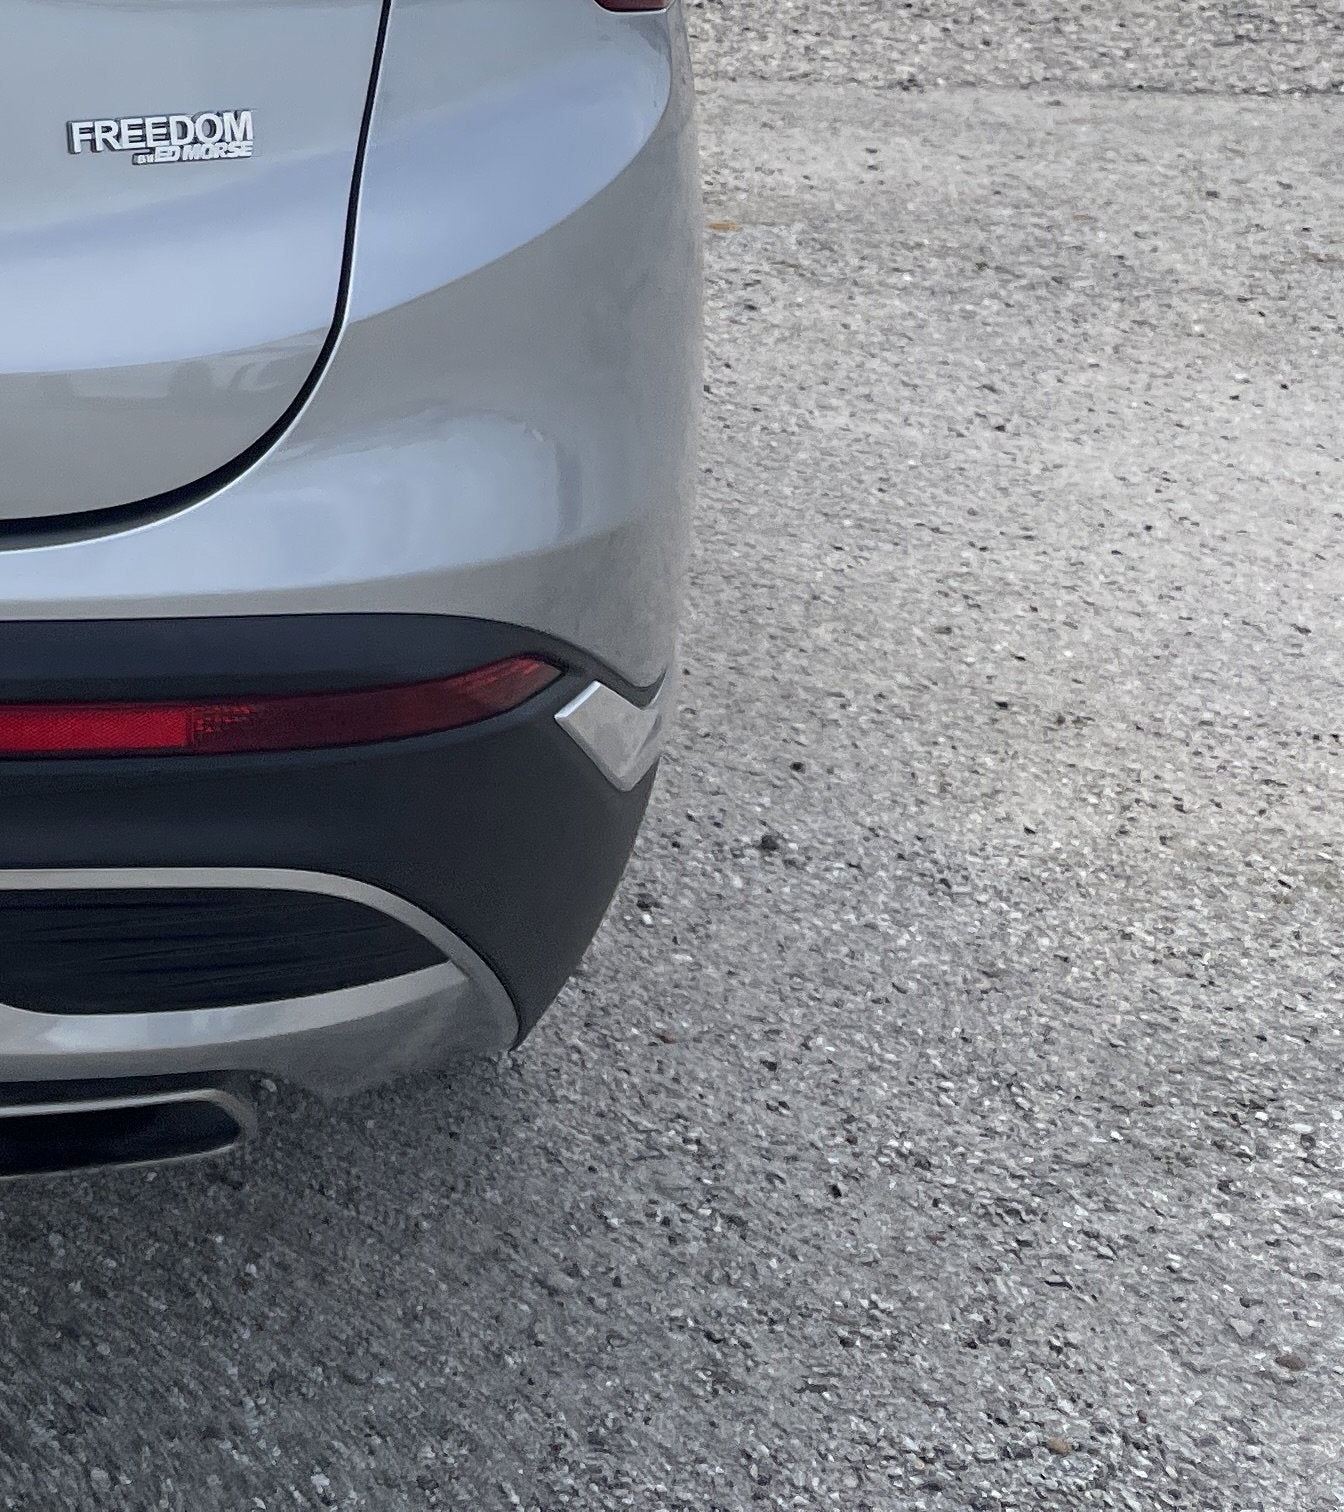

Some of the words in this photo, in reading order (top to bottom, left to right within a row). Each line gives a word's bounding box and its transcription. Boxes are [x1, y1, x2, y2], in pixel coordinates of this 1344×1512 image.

[68, 110, 254, 153] FREEDOM
[154, 145, 180, 162] ED
[182, 141, 253, 161] MORSE
